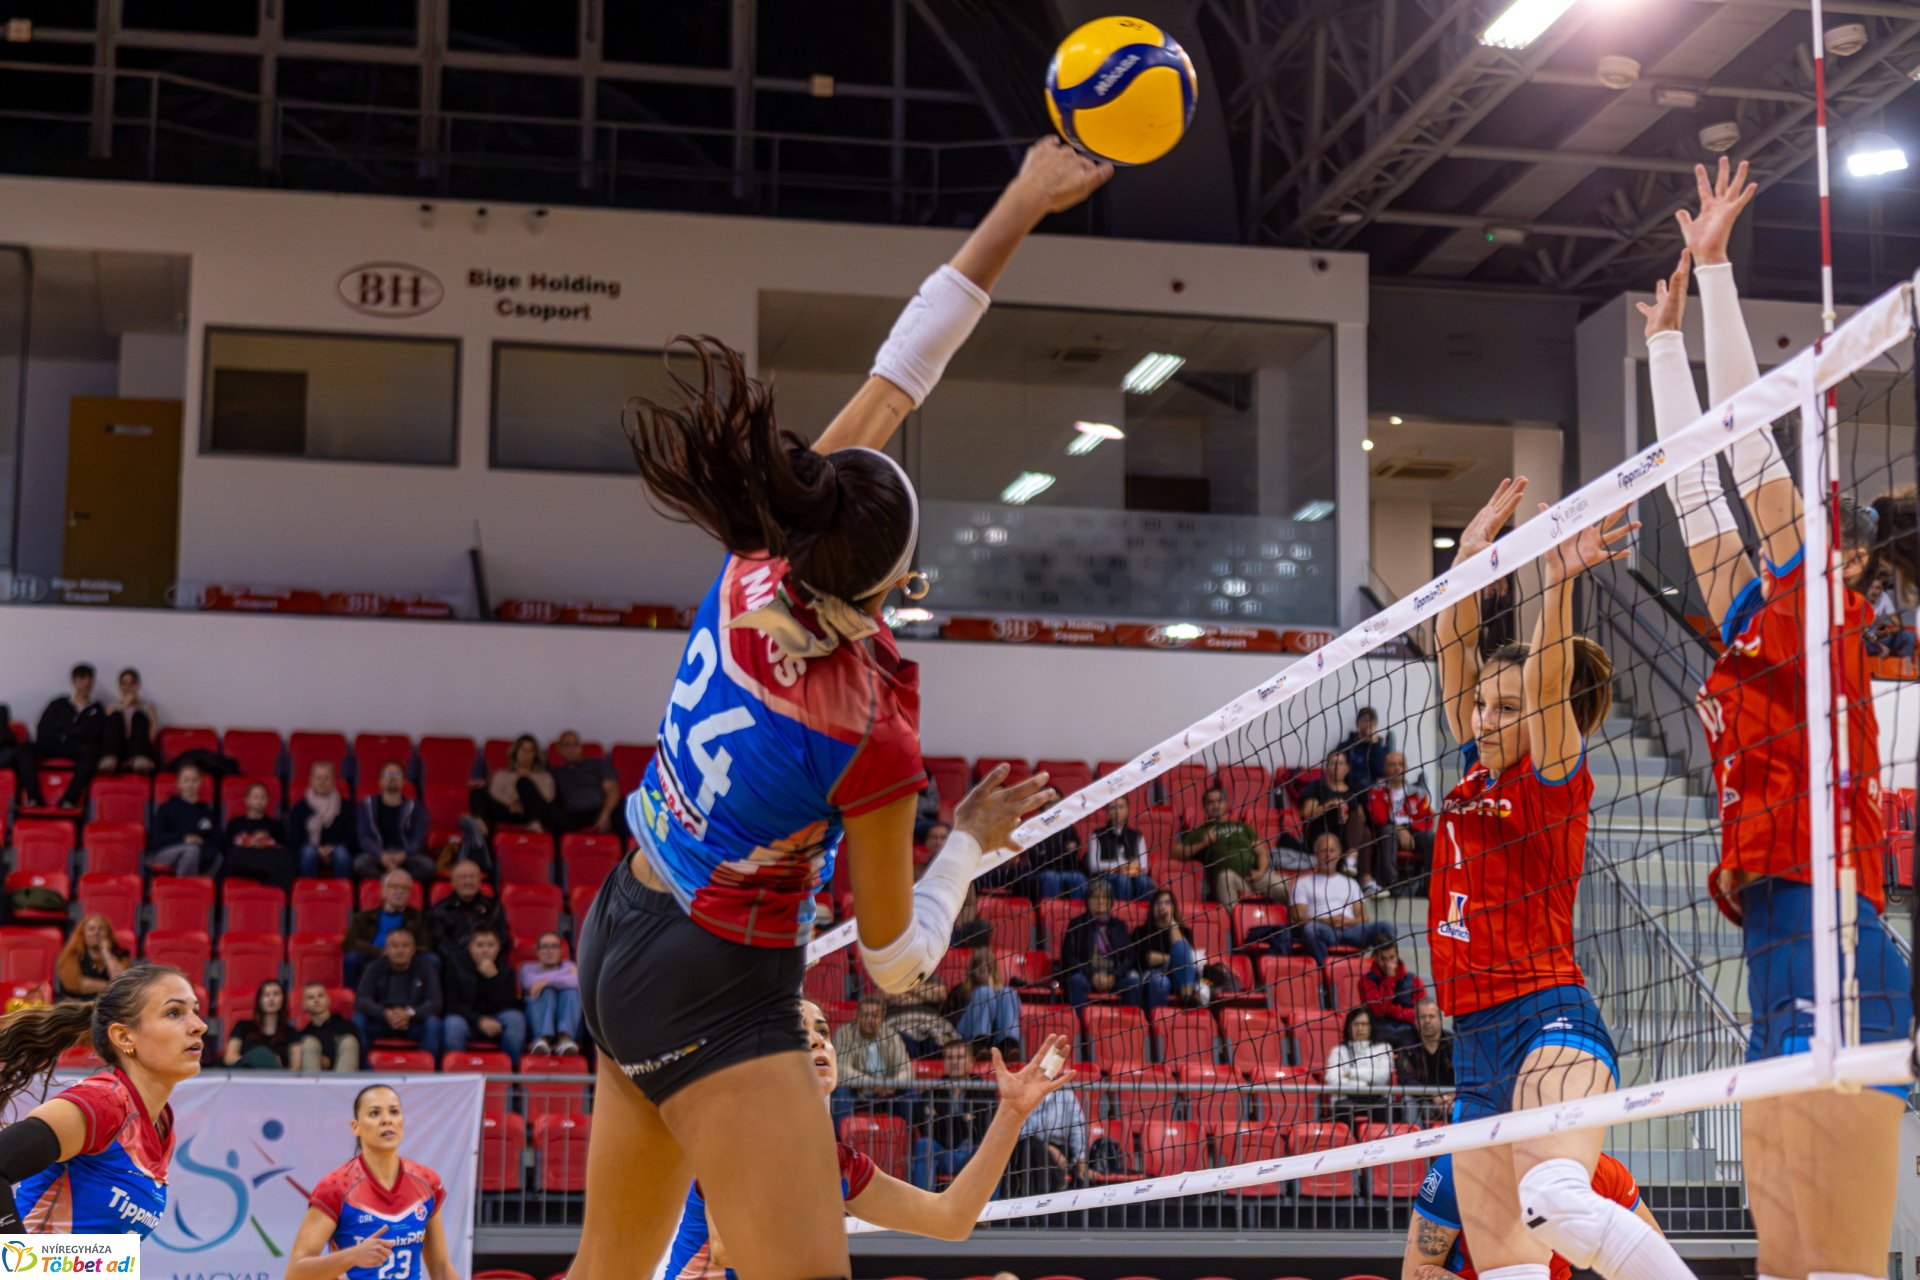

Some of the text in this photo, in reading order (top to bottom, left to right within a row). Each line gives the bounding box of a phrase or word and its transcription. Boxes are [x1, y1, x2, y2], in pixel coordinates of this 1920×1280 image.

[360, 272, 422, 308] BH
[467, 268, 621, 298] Bige Holding
[497, 299, 591, 321] Csoport
[664, 627, 756, 816] 24
[378, 1249, 412, 1280] 23
